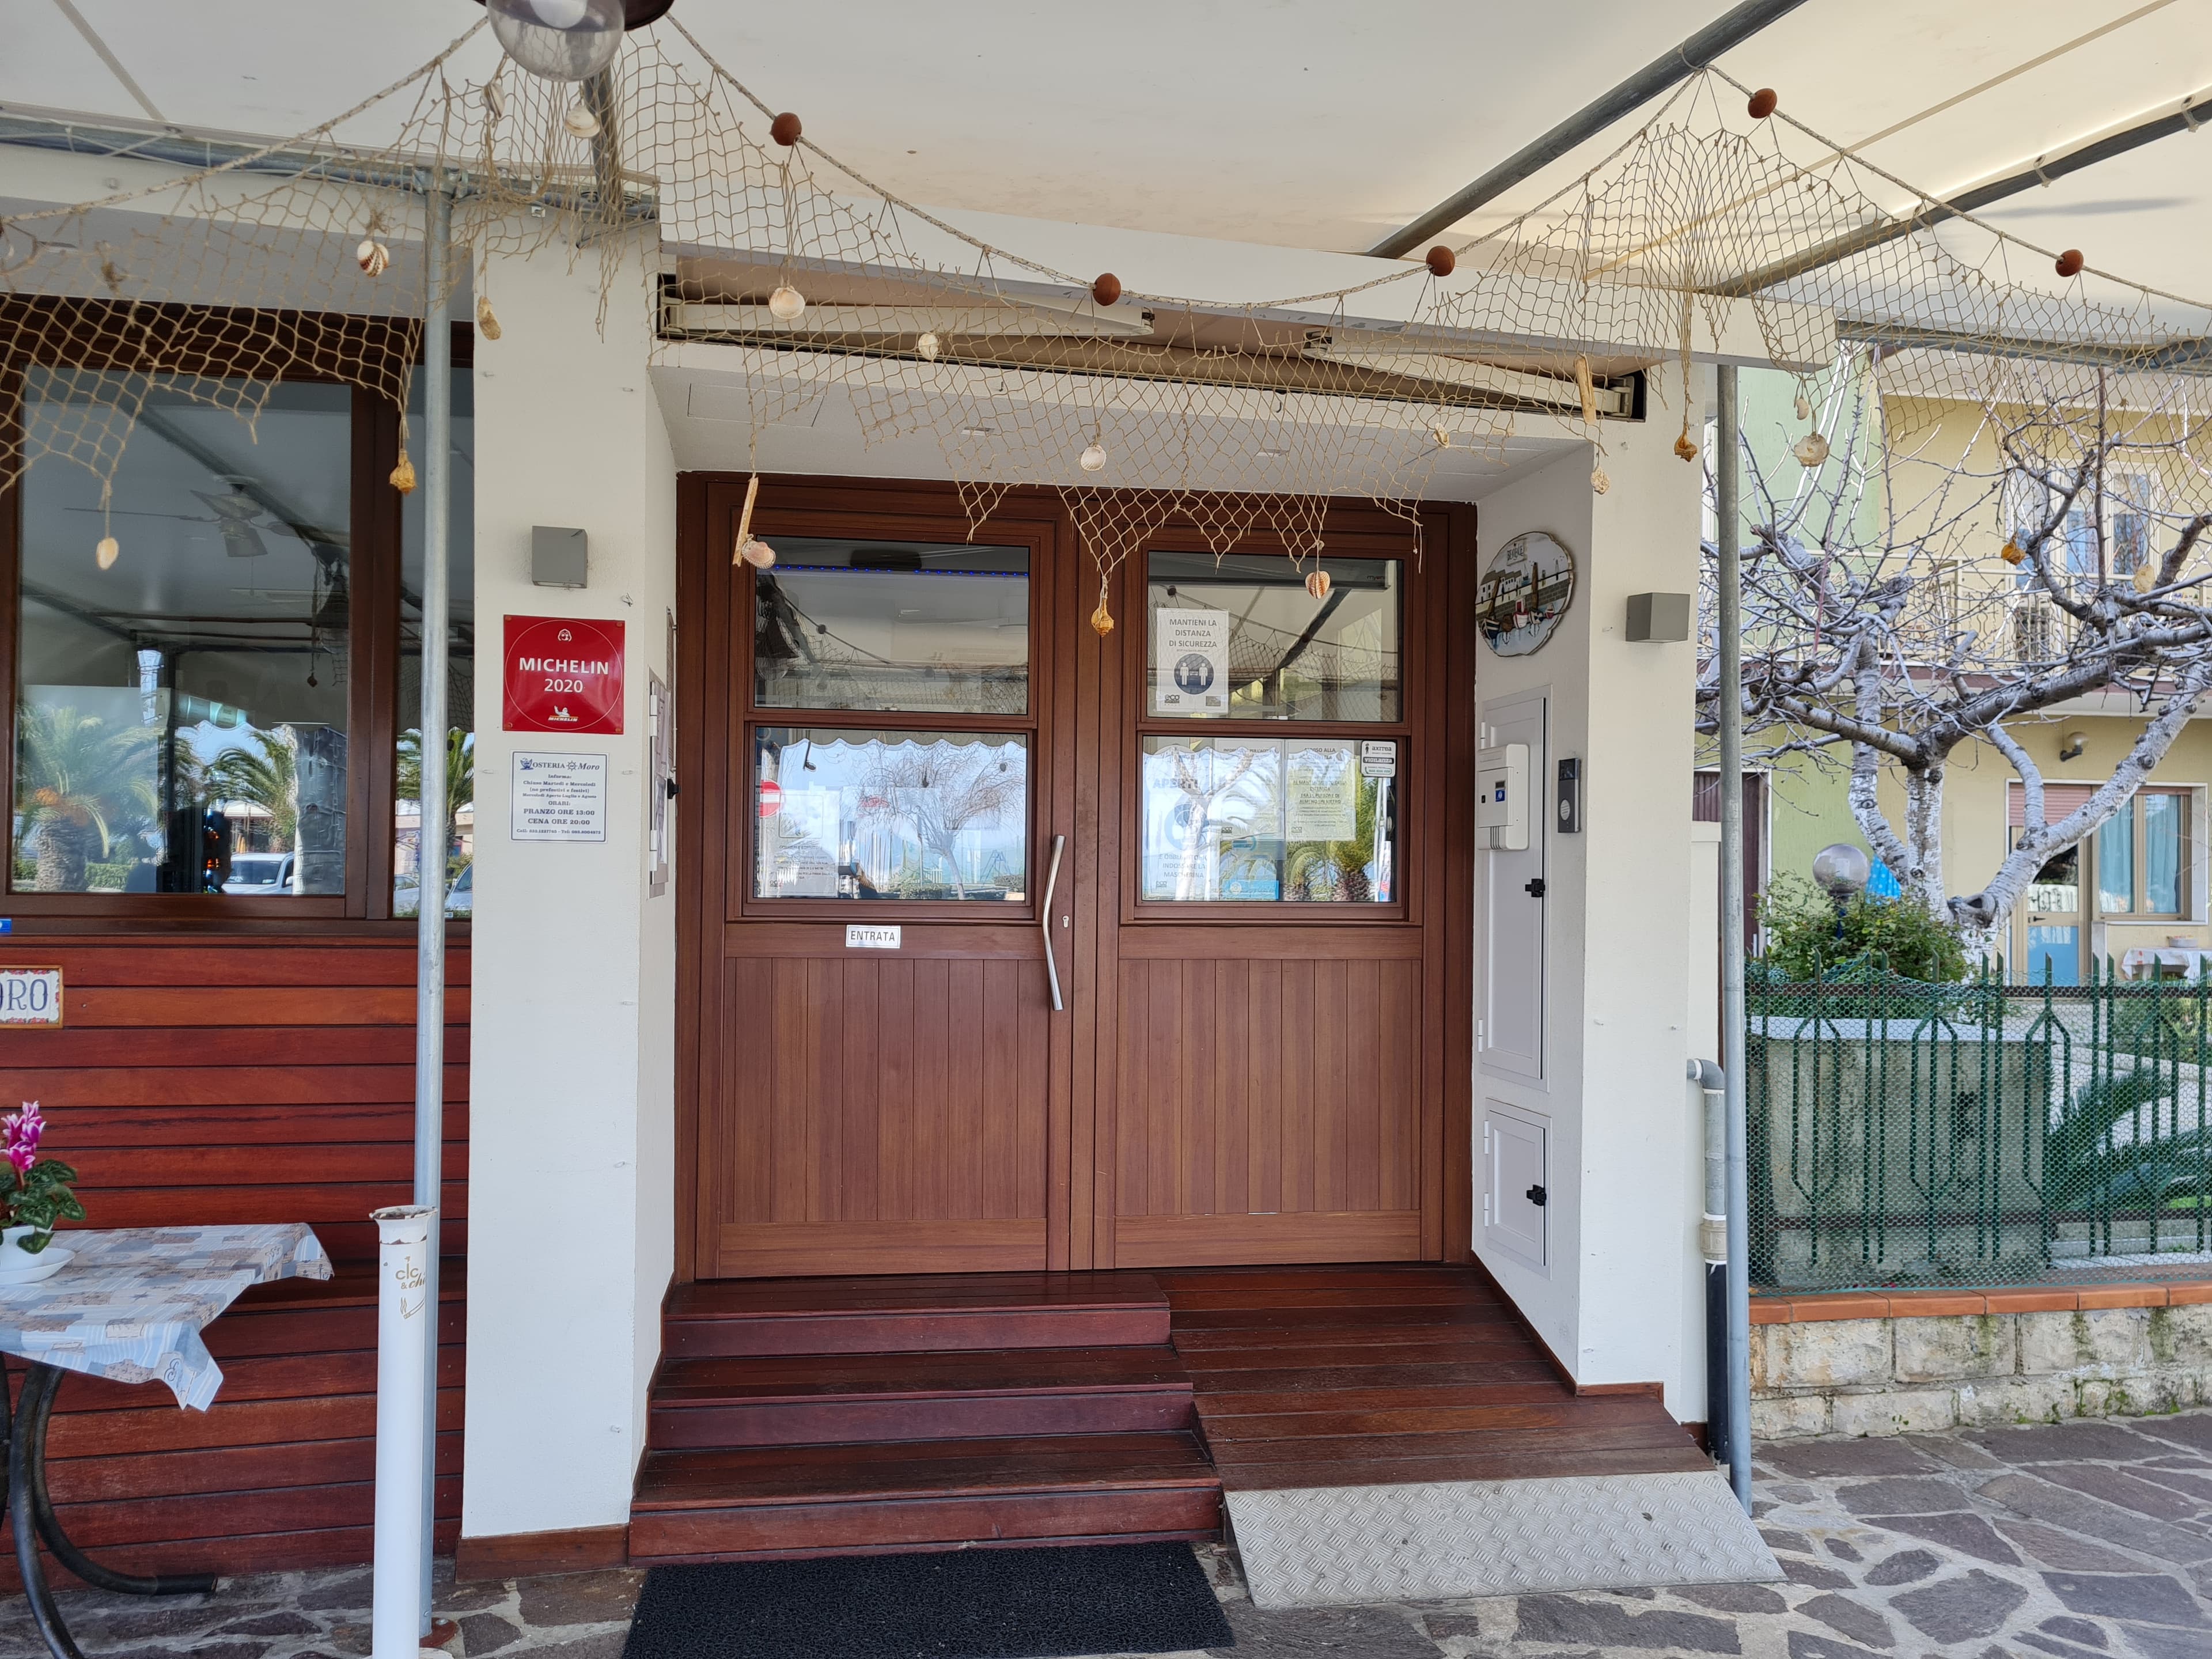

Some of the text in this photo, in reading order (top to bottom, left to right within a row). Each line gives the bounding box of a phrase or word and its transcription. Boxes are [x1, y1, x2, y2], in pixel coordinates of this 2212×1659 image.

[520, 657, 609, 675] MICHELIN
[544, 679, 584, 693] 2020
[850, 930, 895, 941] ENTRATA
